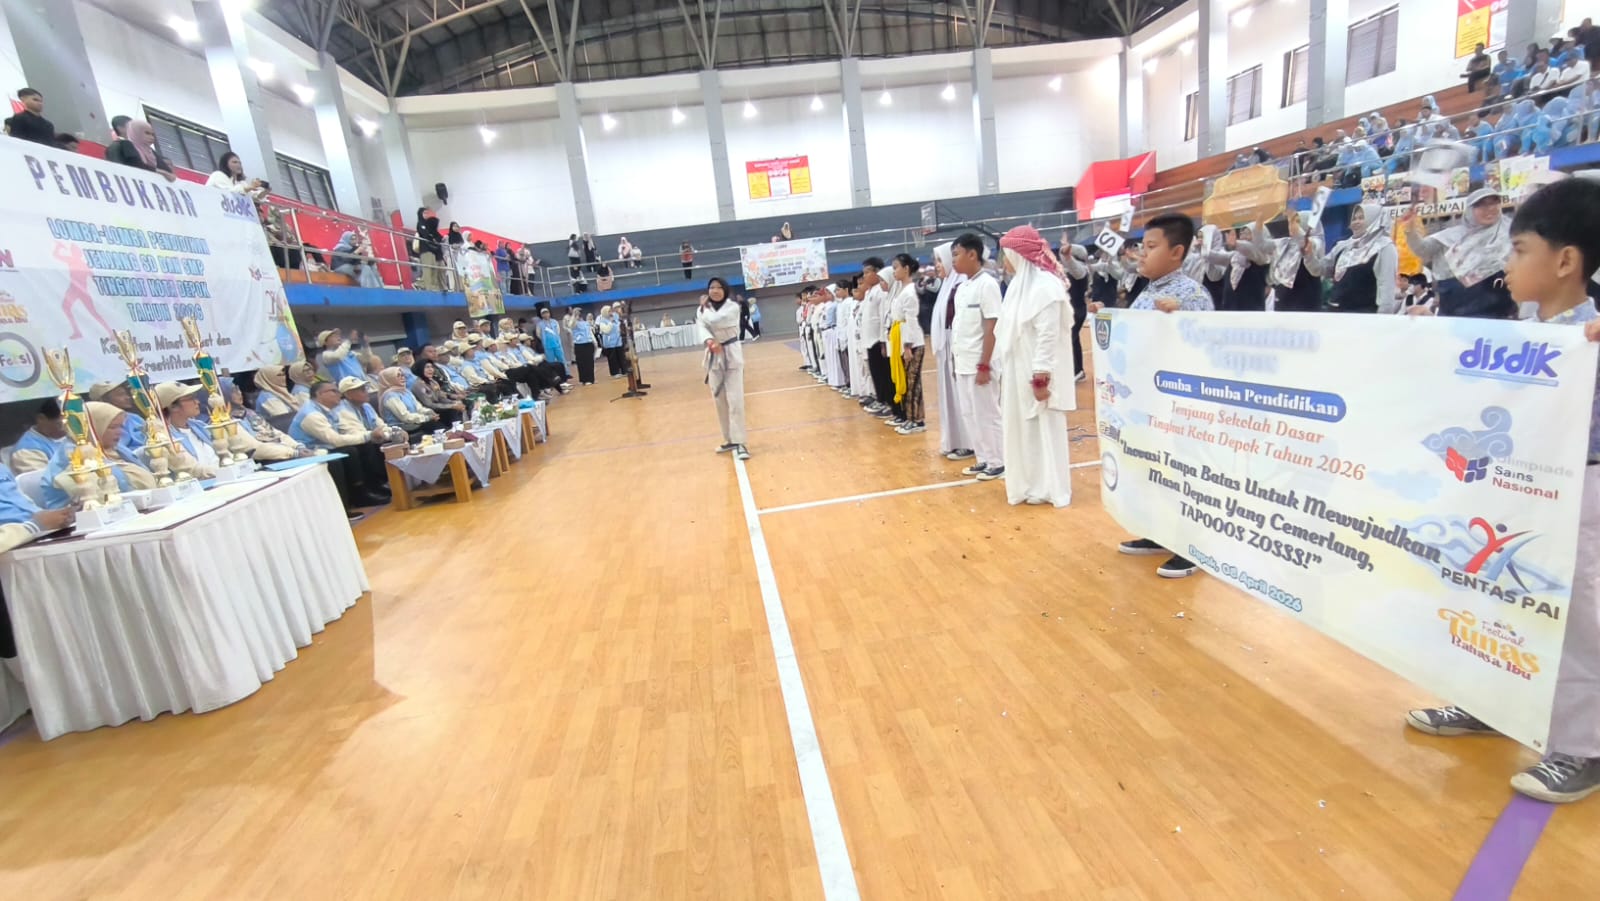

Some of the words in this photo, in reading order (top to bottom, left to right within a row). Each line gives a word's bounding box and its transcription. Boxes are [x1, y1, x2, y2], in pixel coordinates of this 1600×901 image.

[24, 154, 198, 218] PEMBUKAAN
[84, 249, 141, 271] JENJANG
[140, 254, 159, 272] SD
[157, 256, 182, 273] DAN
[181, 258, 205, 276] SMP
[147, 231, 211, 255] PENDIDIKAN
[92, 275, 148, 296] TINGKAT
[146, 278, 178, 297] KOTA
[176, 280, 211, 298] DEPOK
[127, 302, 172, 321] TAHUN
[1458, 337, 1562, 378] disdik
[1156, 375, 1193, 394] Lomba
[1201, 381, 1242, 402] lomba
[1244, 388, 1340, 418] Pendidikan
[1170, 400, 1216, 425] Jenjang
[1217, 410, 1272, 434] Sekolah
[1275, 421, 1325, 445] Dasar
[1146, 414, 1186, 436] Tingkat
[1187, 422, 1216, 444] Kota
[1217, 430, 1261, 455] Depok
[1264, 442, 1314, 469] Tahun
[1318, 454, 1366, 482] 2026
[1492, 477, 1559, 500] Nasional
[1495, 465, 1534, 482] Sains
[1148, 468, 1181, 493] Masa
[1182, 483, 1223, 512] Depan
[1224, 496, 1266, 529] Yang
[1268, 512, 1376, 573] Cemerlang,
[1162, 451, 1198, 478] Tanpa
[1200, 465, 1242, 492] Batas
[1244, 478, 1300, 511] Untuk
[1301, 494, 1442, 563] Mewujudkan
[1180, 501, 1247, 543] TAPOOOS
[1239, 569, 1268, 595] April
[1269, 583, 1303, 612] 2026
[1441, 567, 1517, 604] PENTAS
[1520, 597, 1560, 620] PAI
[1437, 608, 1541, 673] Tunas
[1505, 661, 1531, 681] Ibu
